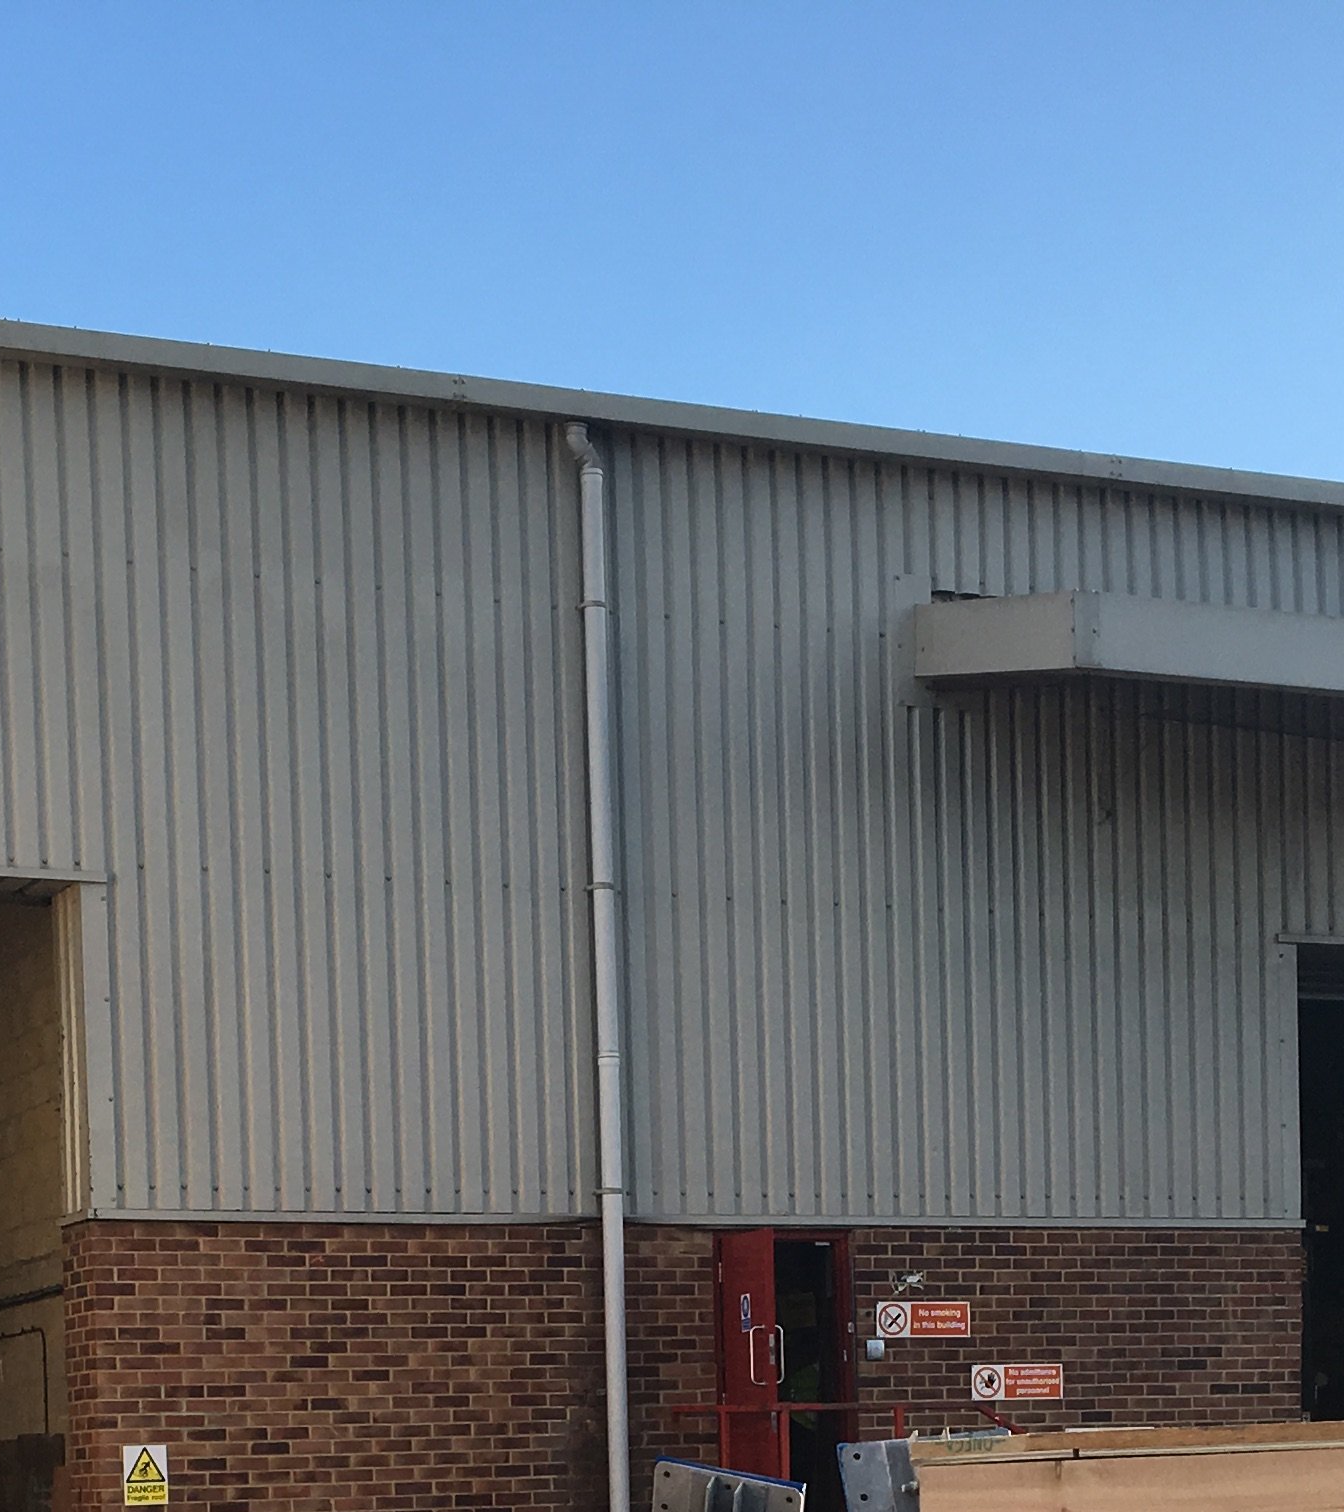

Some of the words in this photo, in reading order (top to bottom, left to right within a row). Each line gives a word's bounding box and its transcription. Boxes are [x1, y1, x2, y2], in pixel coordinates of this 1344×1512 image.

[918, 1308, 929, 1317] No
[930, 1308, 961, 1318] smoking
[913, 1320, 921, 1329] in
[921, 1320, 936, 1329] this
[936, 1320, 966, 1331] building
[1008, 1368, 1019, 1376] No
[127, 1485, 165, 1494] DANGER
